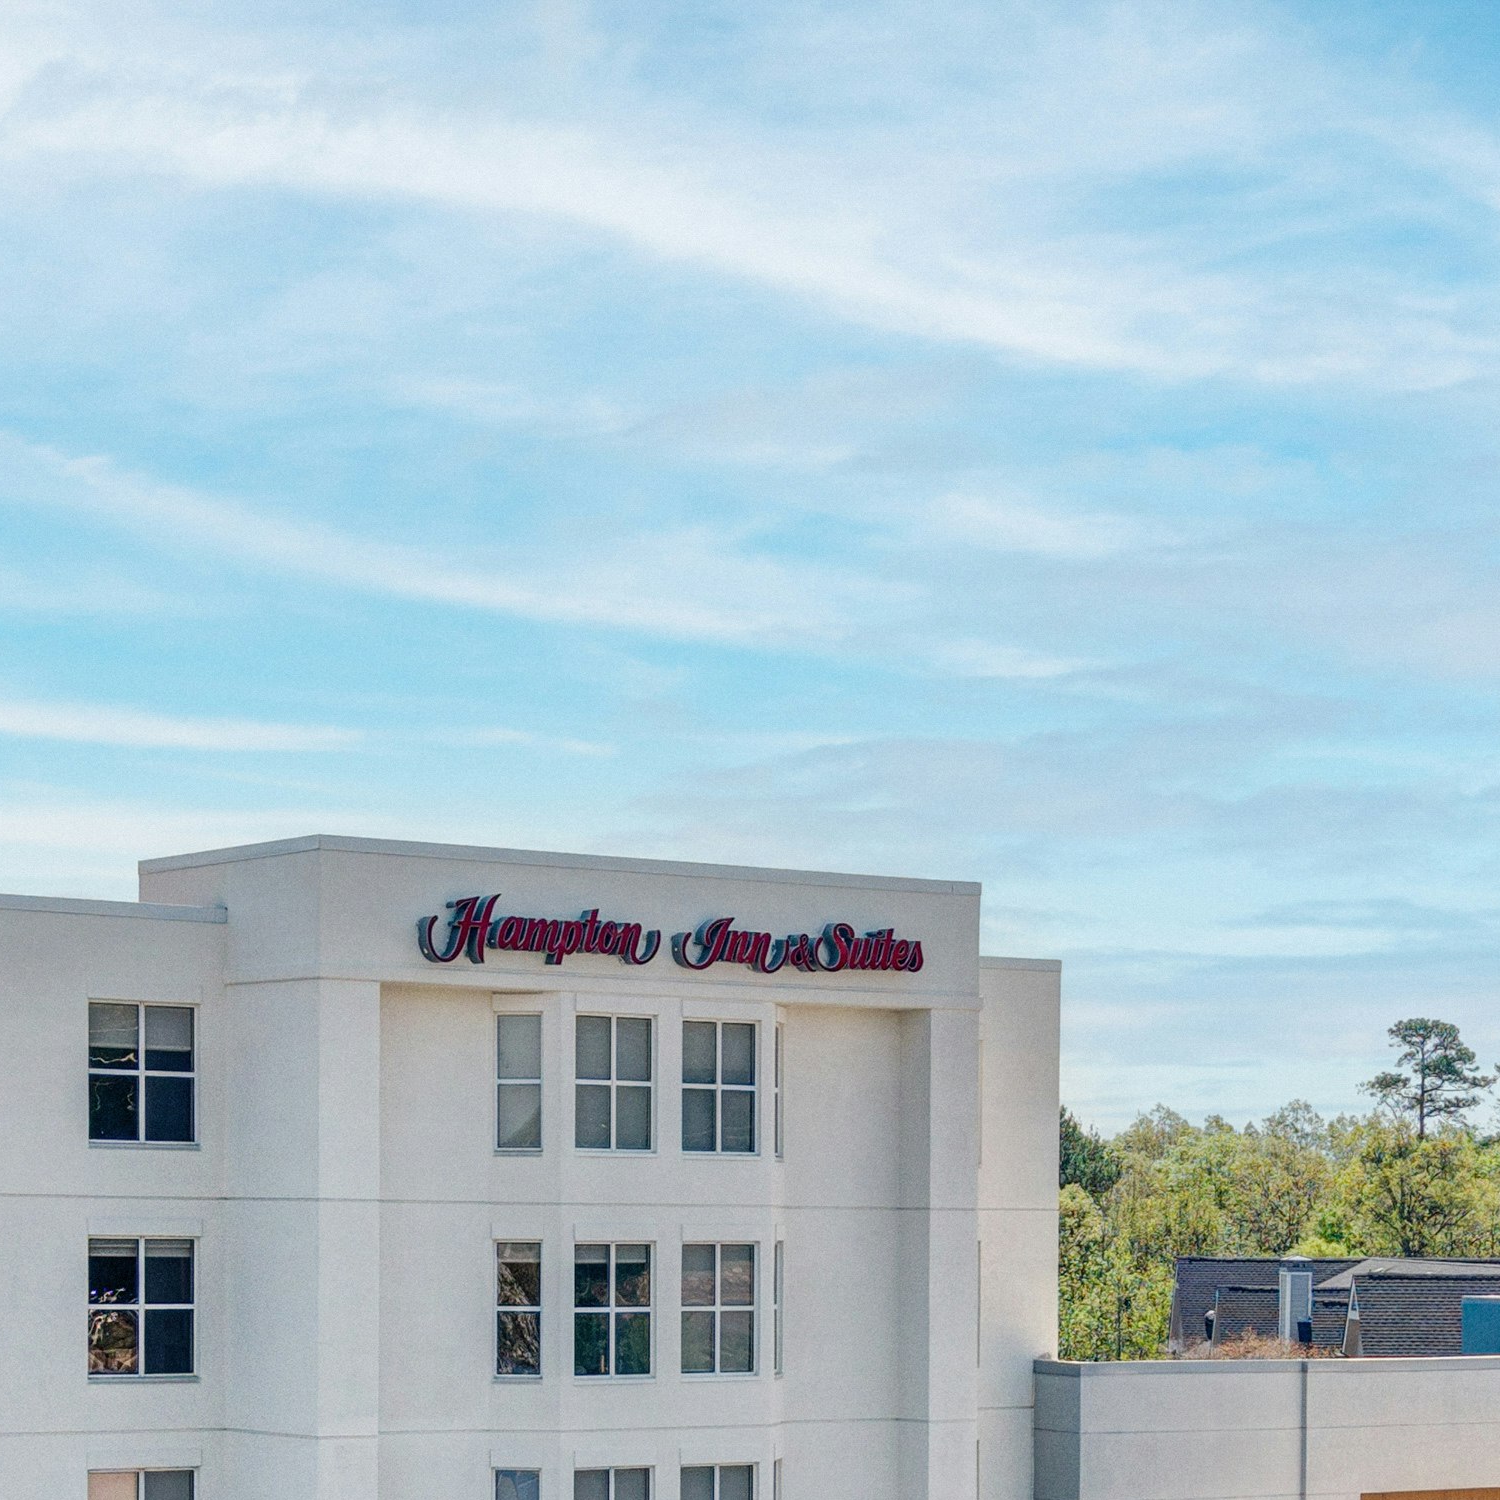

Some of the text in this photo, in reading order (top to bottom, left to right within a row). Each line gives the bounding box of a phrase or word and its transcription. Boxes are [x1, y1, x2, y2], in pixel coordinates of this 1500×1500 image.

[419, 893, 924, 973] Hampton Inn & Suites
